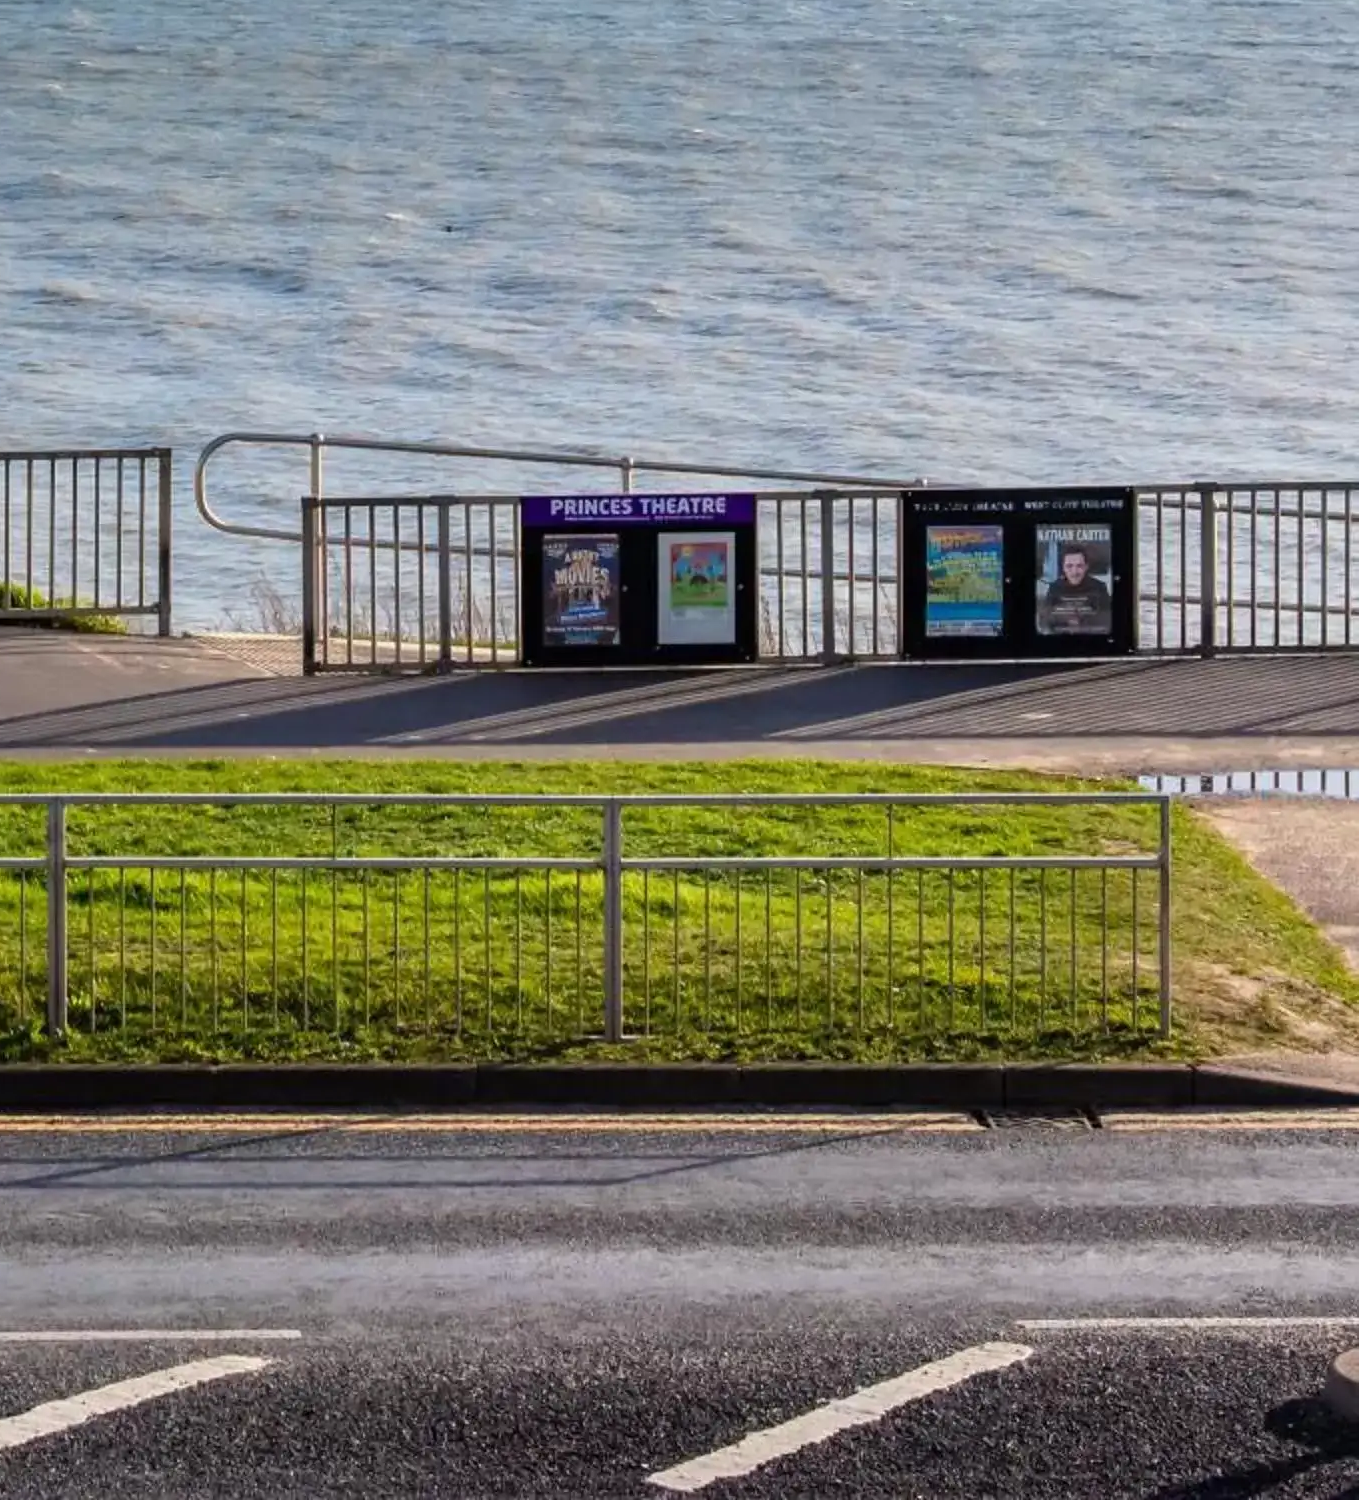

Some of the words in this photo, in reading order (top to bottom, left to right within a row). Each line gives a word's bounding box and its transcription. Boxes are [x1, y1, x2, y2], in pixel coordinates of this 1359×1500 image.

[550, 498, 633, 516] PRINCES
[639, 496, 727, 515] THEATRE
[554, 566, 610, 585] MOVIES
